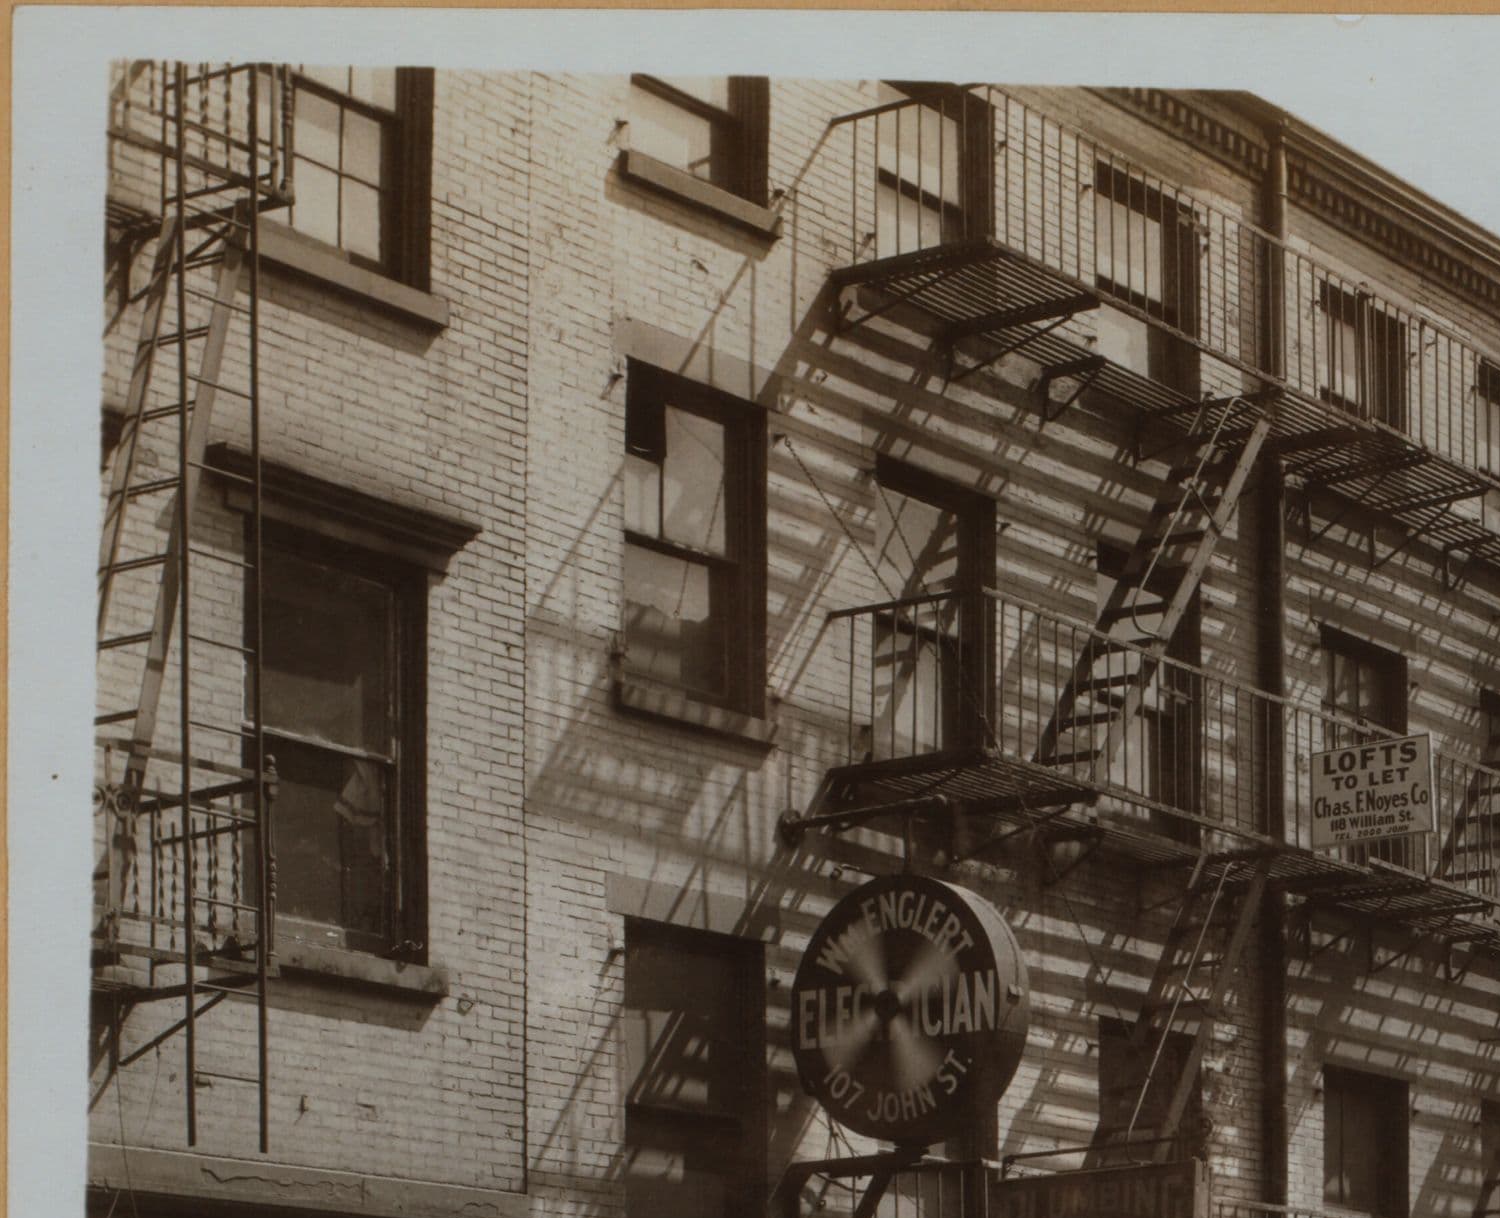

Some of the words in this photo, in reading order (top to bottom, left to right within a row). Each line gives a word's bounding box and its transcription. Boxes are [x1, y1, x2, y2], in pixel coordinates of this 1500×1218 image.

[1323, 741, 1417, 776] LOFTS
[1332, 775, 1358, 791] TO
[1369, 767, 1409, 786] LET
[1314, 797, 1353, 819] Chas.
[1349, 814, 1395, 829] William
[861, 890, 975, 955] ENGLERT
[824, 1064, 865, 1109] 107
[866, 1085, 937, 1123] JOHN
[936, 1048, 973, 1095] ST.
